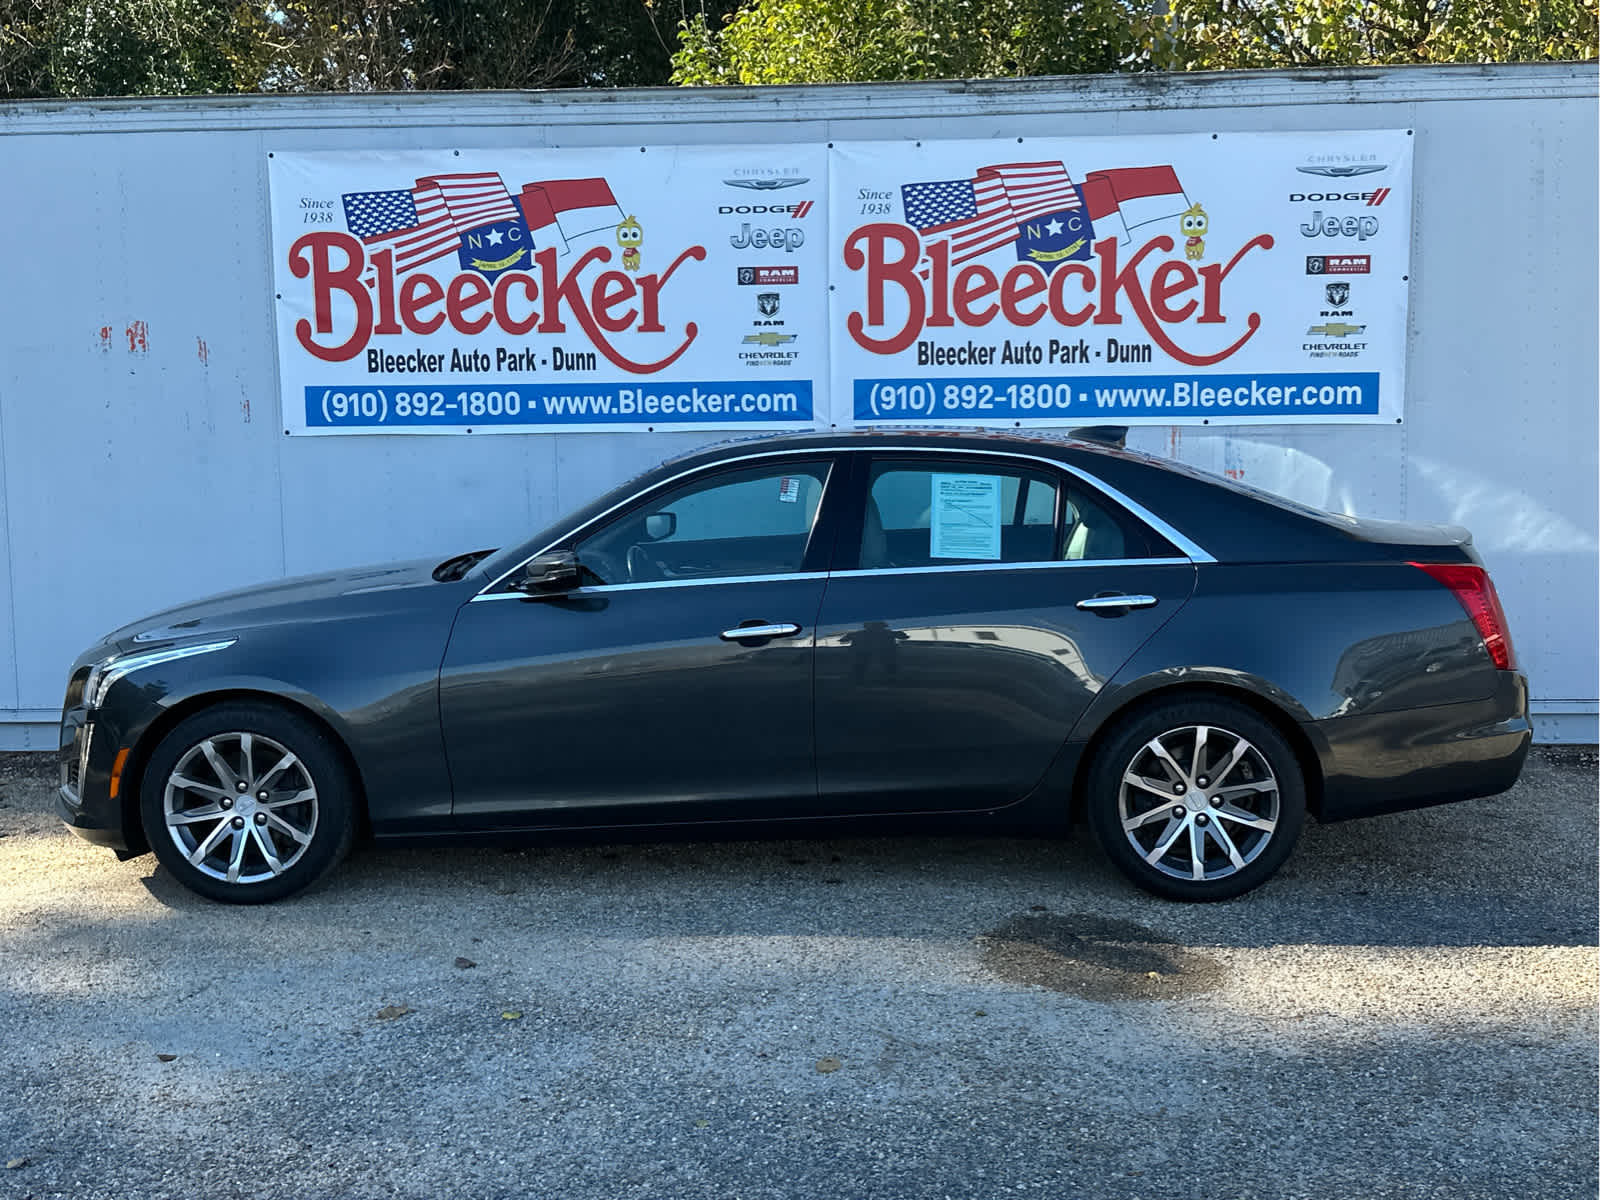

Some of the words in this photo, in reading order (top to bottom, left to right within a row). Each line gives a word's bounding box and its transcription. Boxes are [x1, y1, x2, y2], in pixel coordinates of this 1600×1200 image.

[1305, 154, 1377, 162] CHRYSLER
[733, 168, 800, 176] CHRYSLER
[857, 188, 893, 200] Since
[1289, 192, 1376, 202] DODGE
[299, 198, 334, 209] Since
[718, 204, 801, 214] DODGE
[860, 203, 891, 215] 1938
[303, 212, 334, 224] 1938
[1300, 211, 1379, 241] Jeep
[730, 223, 804, 252] Jeep
[844, 223, 1274, 366] Bleecker
[288, 232, 707, 374] Bleecker
[917, 341, 996, 365] Bleecker
[1001, 340, 1042, 365] Auto
[1049, 338, 1090, 364] Park
[1107, 338, 1152, 363] Dunn
[1302, 342, 1368, 350] CHEVROLET
[367, 349, 444, 373] Bleecker
[450, 348, 490, 373] Auto
[497, 347, 536, 372] Park
[552, 347, 597, 371] Dunn
[738, 351, 800, 359] CHEVROLET
[870, 382, 936, 415] (910)
[943, 384, 1071, 409] 892-1800
[1094, 380, 1362, 408] www.Bleecker.com
[321, 389, 388, 422] (910)
[395, 391, 521, 416] 892-1800
[544, 388, 798, 415] www.Bleecker.com
